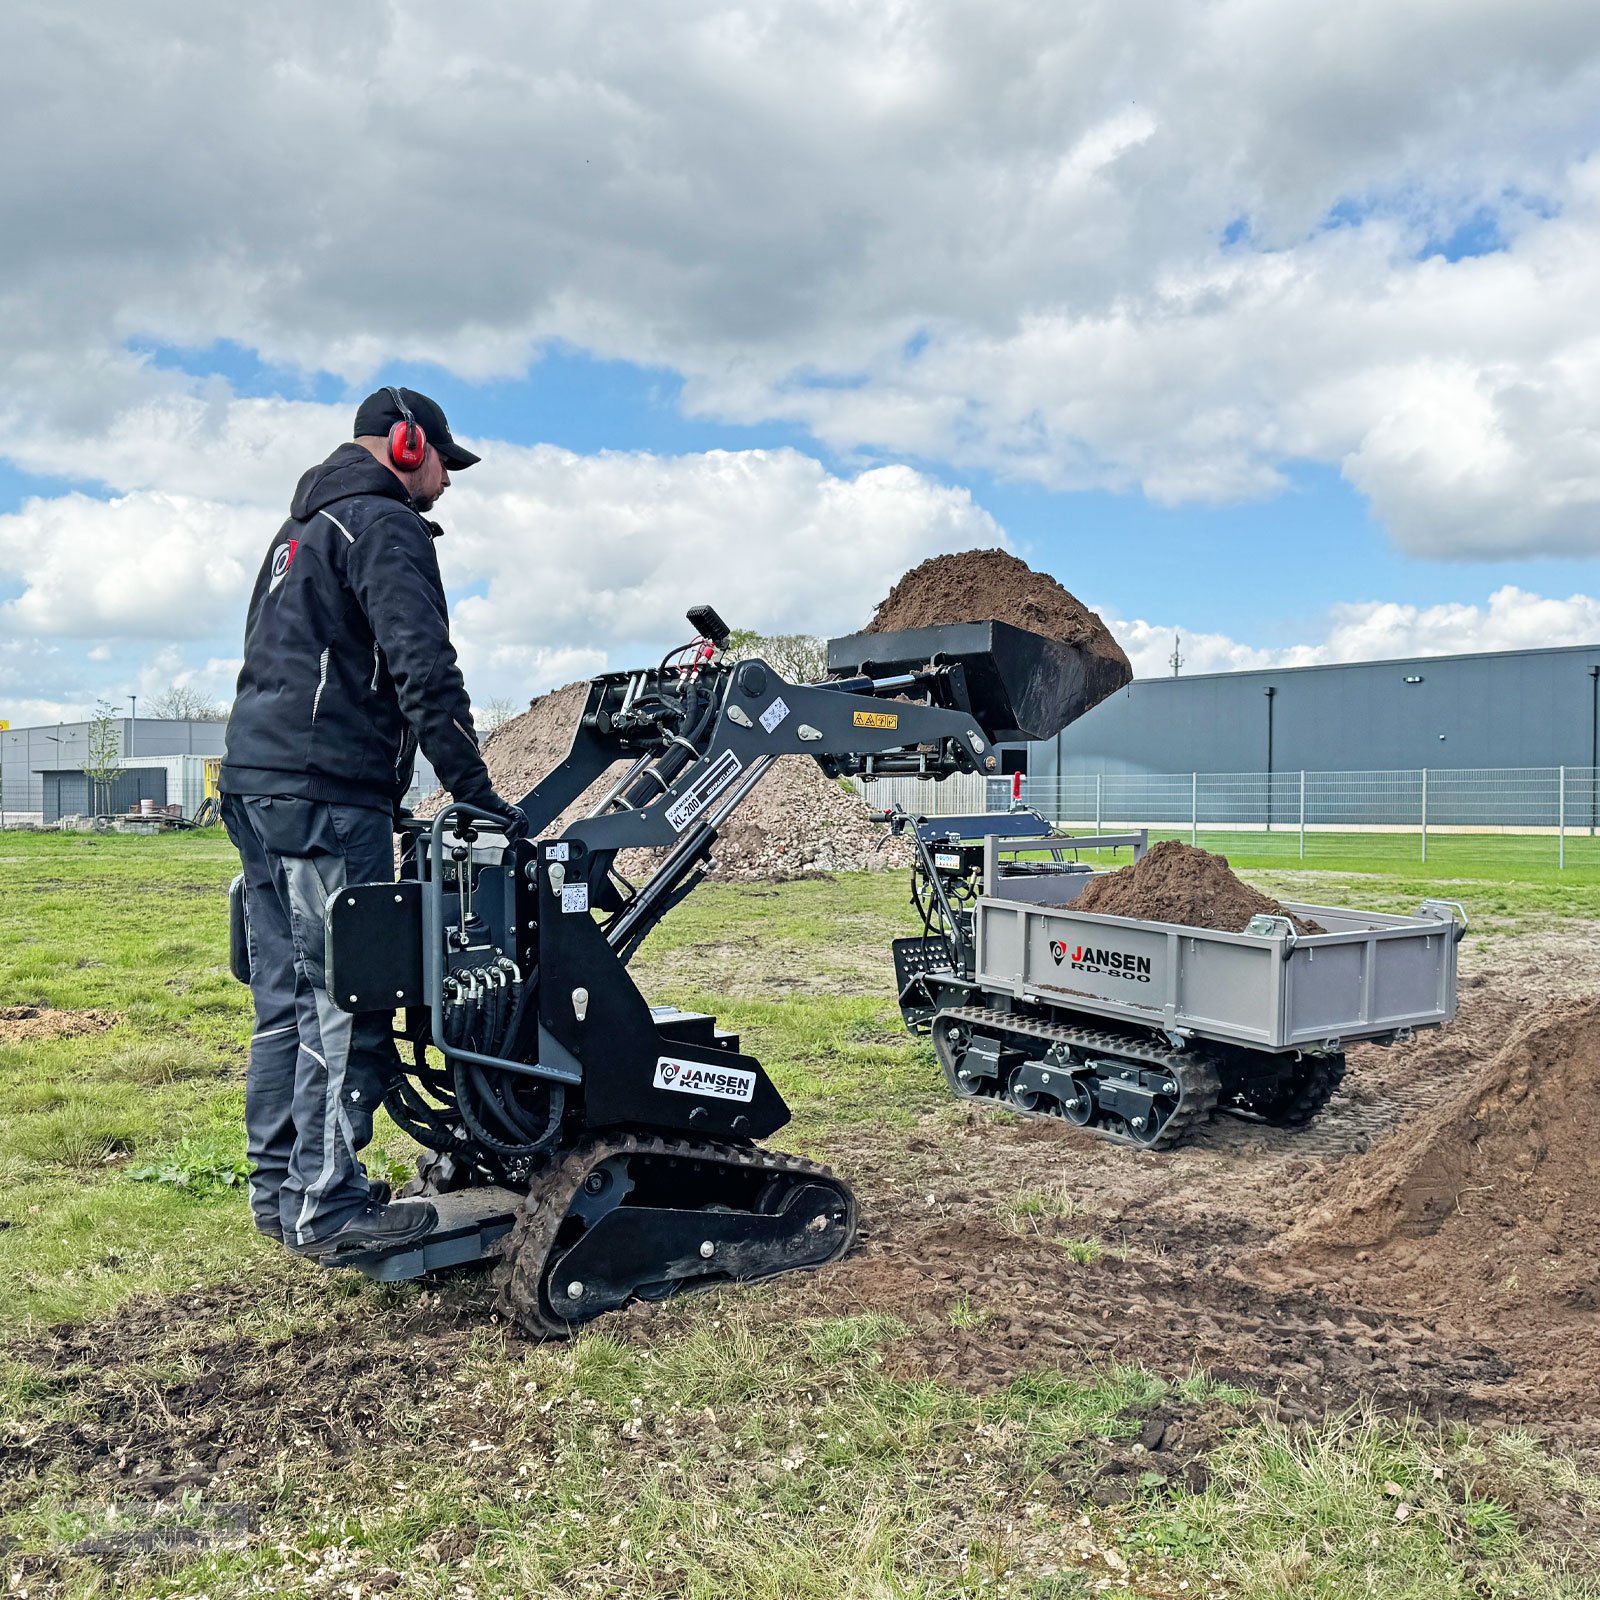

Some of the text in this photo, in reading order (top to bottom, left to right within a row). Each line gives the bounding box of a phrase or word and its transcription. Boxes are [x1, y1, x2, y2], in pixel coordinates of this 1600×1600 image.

[672, 798, 700, 828] KL-200
[1071, 946, 1151, 974] JANSEN
[1071, 962, 1151, 983] RD-800
[679, 1080, 748, 1097] KL-200
[682, 1069, 750, 1090] JANSEN
